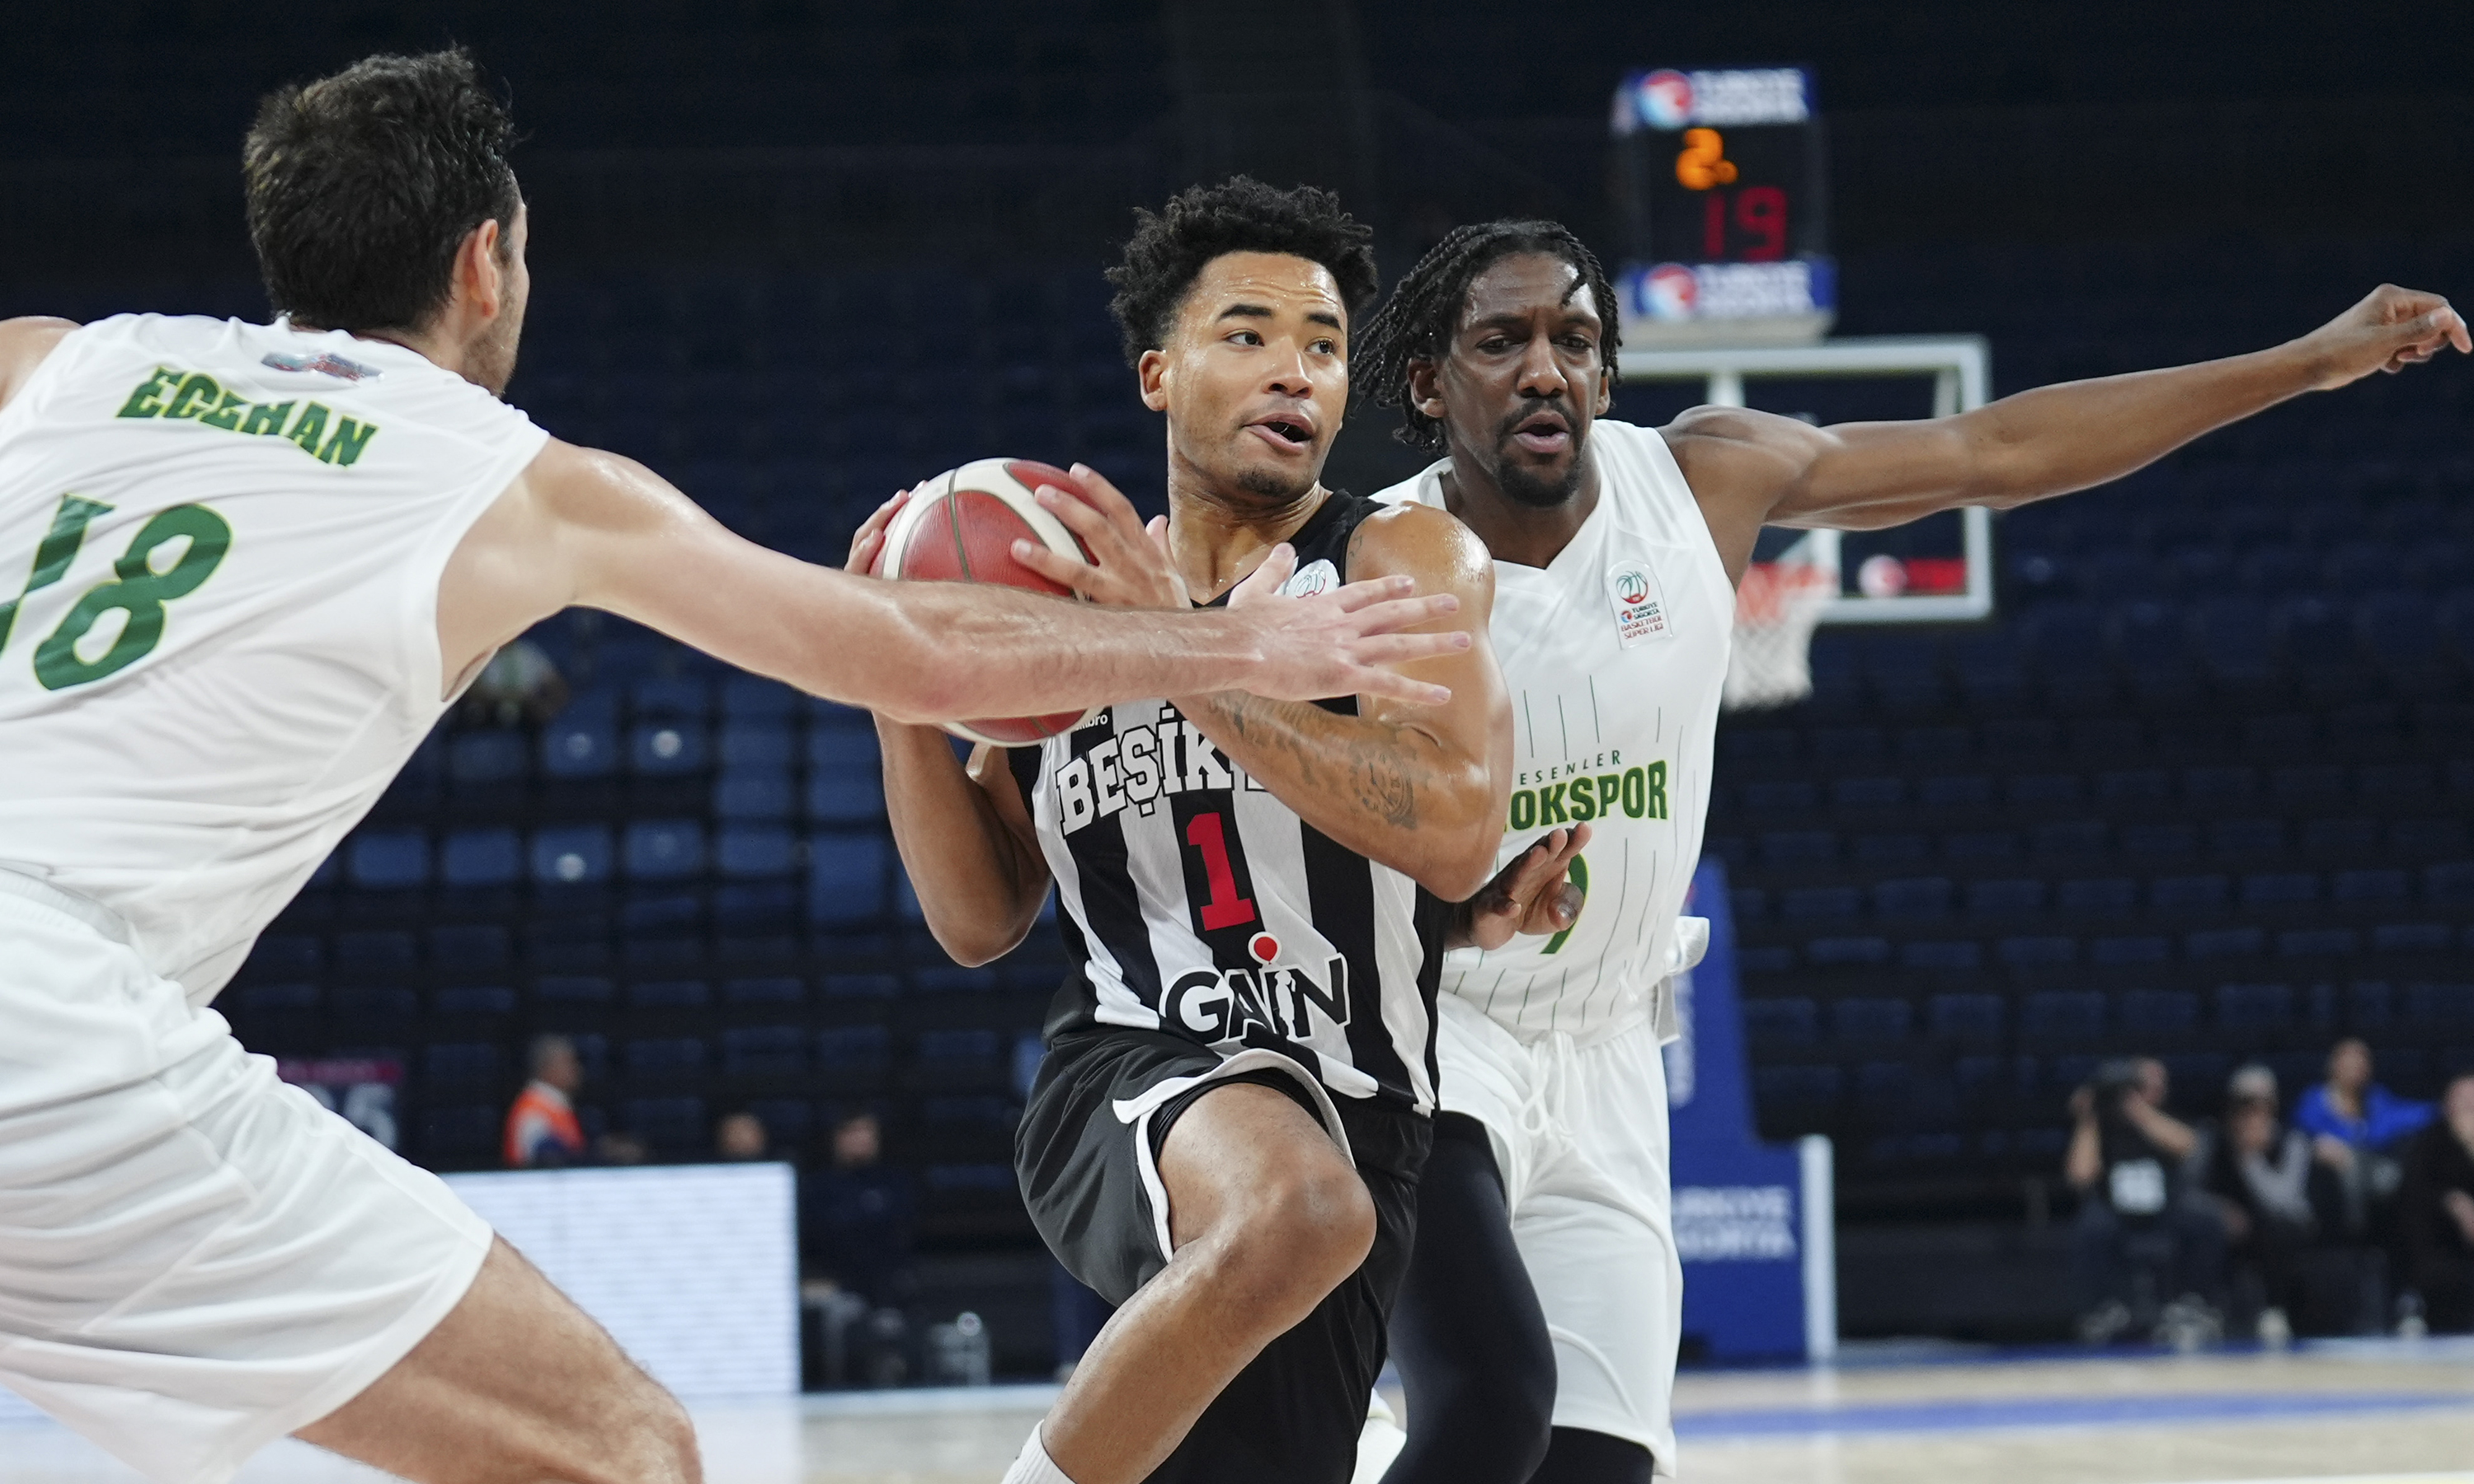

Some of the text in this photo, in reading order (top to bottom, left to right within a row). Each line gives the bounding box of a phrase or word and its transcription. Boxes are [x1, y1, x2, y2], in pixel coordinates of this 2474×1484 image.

[1704, 186, 1787, 262] 19
[0, 493, 233, 692] 18
[1056, 707, 1268, 839] BEŞİK
[1504, 759, 1667, 833] OKSPOR
[1520, 749, 1621, 785] ESENLER
[1186, 812, 1256, 932] 1
